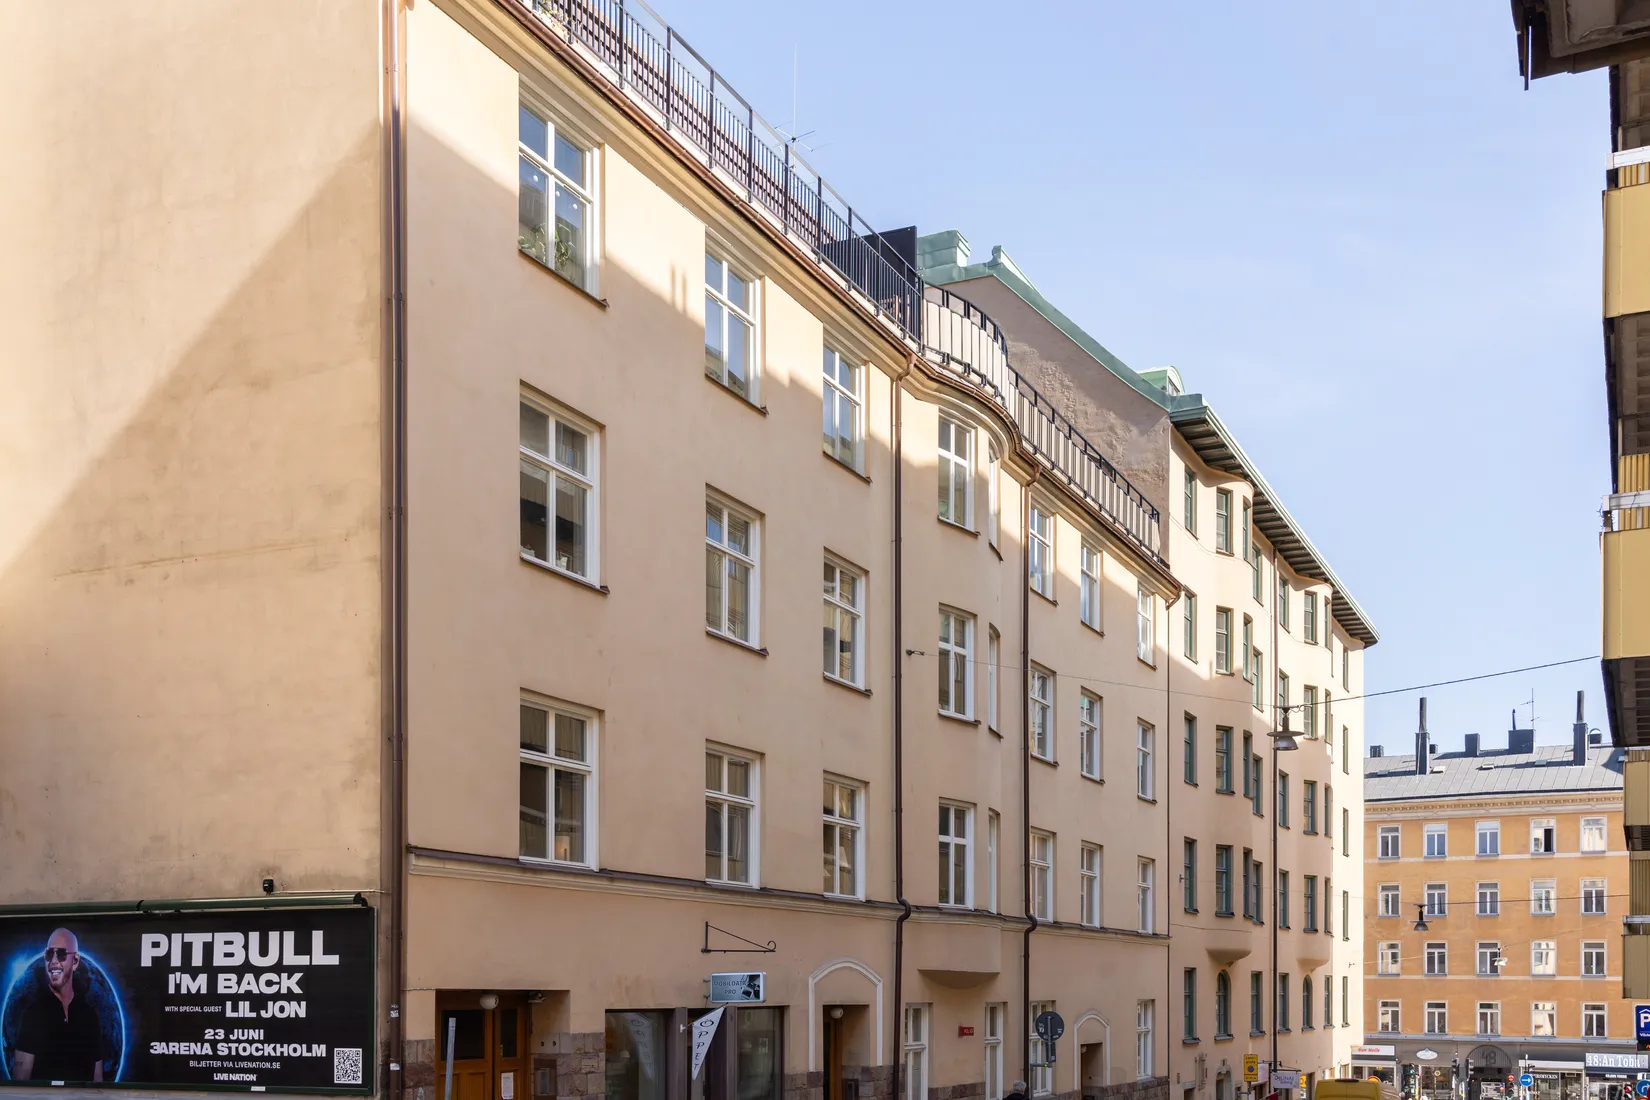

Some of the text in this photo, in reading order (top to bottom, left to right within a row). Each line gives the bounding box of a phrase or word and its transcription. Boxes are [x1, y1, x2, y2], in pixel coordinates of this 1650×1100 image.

[141, 930, 339, 967] PITBULL
[168, 972, 304, 994] I'M BACK
[226, 1001, 257, 1018] LIL
[260, 1001, 306, 1018] JON
[204, 1029, 264, 1040] 23 JUNI
[150, 1042, 326, 1057] 3ARENA STOCKHOLM
[693, 1018, 714, 1071] ÖPPET
[189, 1060, 221, 1068] BILJETTER
[235, 1061, 281, 1069] LIVENATION.SE
[1481, 1051, 1497, 1065] 48
[214, 1073, 257, 1082] LIVE NATION
